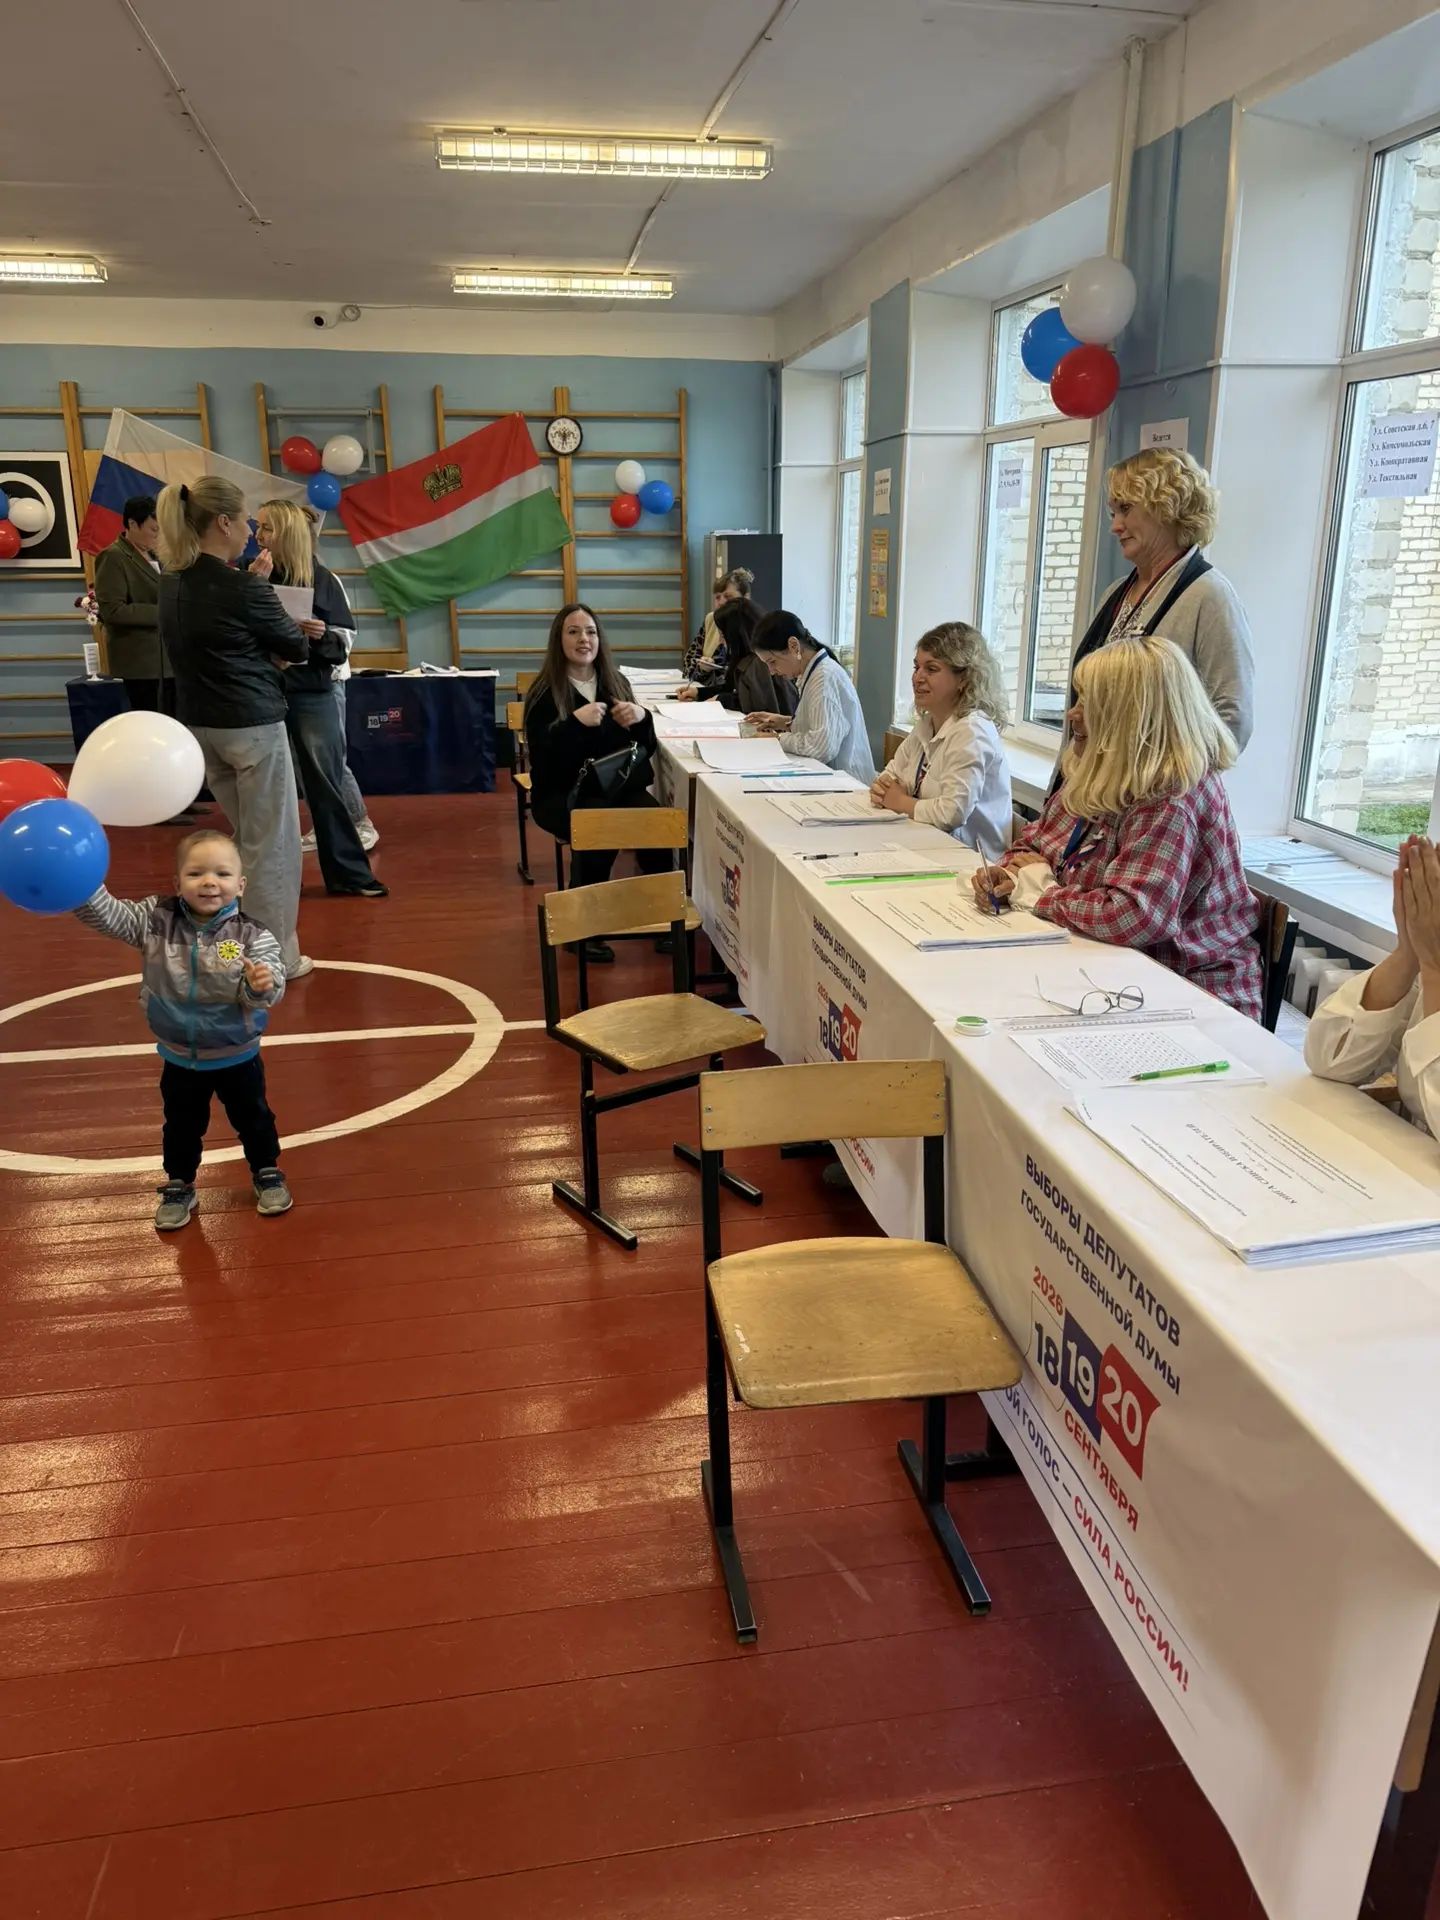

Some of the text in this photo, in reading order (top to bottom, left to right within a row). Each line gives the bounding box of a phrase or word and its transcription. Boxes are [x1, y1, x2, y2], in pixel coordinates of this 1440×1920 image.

[1383, 424, 1416, 434] Советская
[389, 710, 400, 718] 20
[812, 938, 852, 991] ГОСУДАРСТВЕННОЙ
[813, 915, 867, 984] ВЫБОРЫ ДЕПУТАТОВ
[819, 1015, 857, 1056] 18 19 20
[851, 1138, 876, 1181] ОССИИ!
[1025, 1154, 1081, 1234] ВЫБОРЫ
[1083, 1222, 1180, 1347] ДЕПУТАТОВ
[1021, 1188, 1180, 1396] ГОСУДАРСТВЕННОЙ ДУМЫ
[1032, 1265, 1065, 1317] 2026
[1034, 1320, 1143, 1447] 18 19 20
[1064, 1409, 1139, 1532] СЕНТЯБРЯ
[1022, 1407, 1060, 1482] ГОЛОС
[1074, 1495, 1112, 1569] СИЛА
[1114, 1559, 1189, 1692] РОССИИ!
